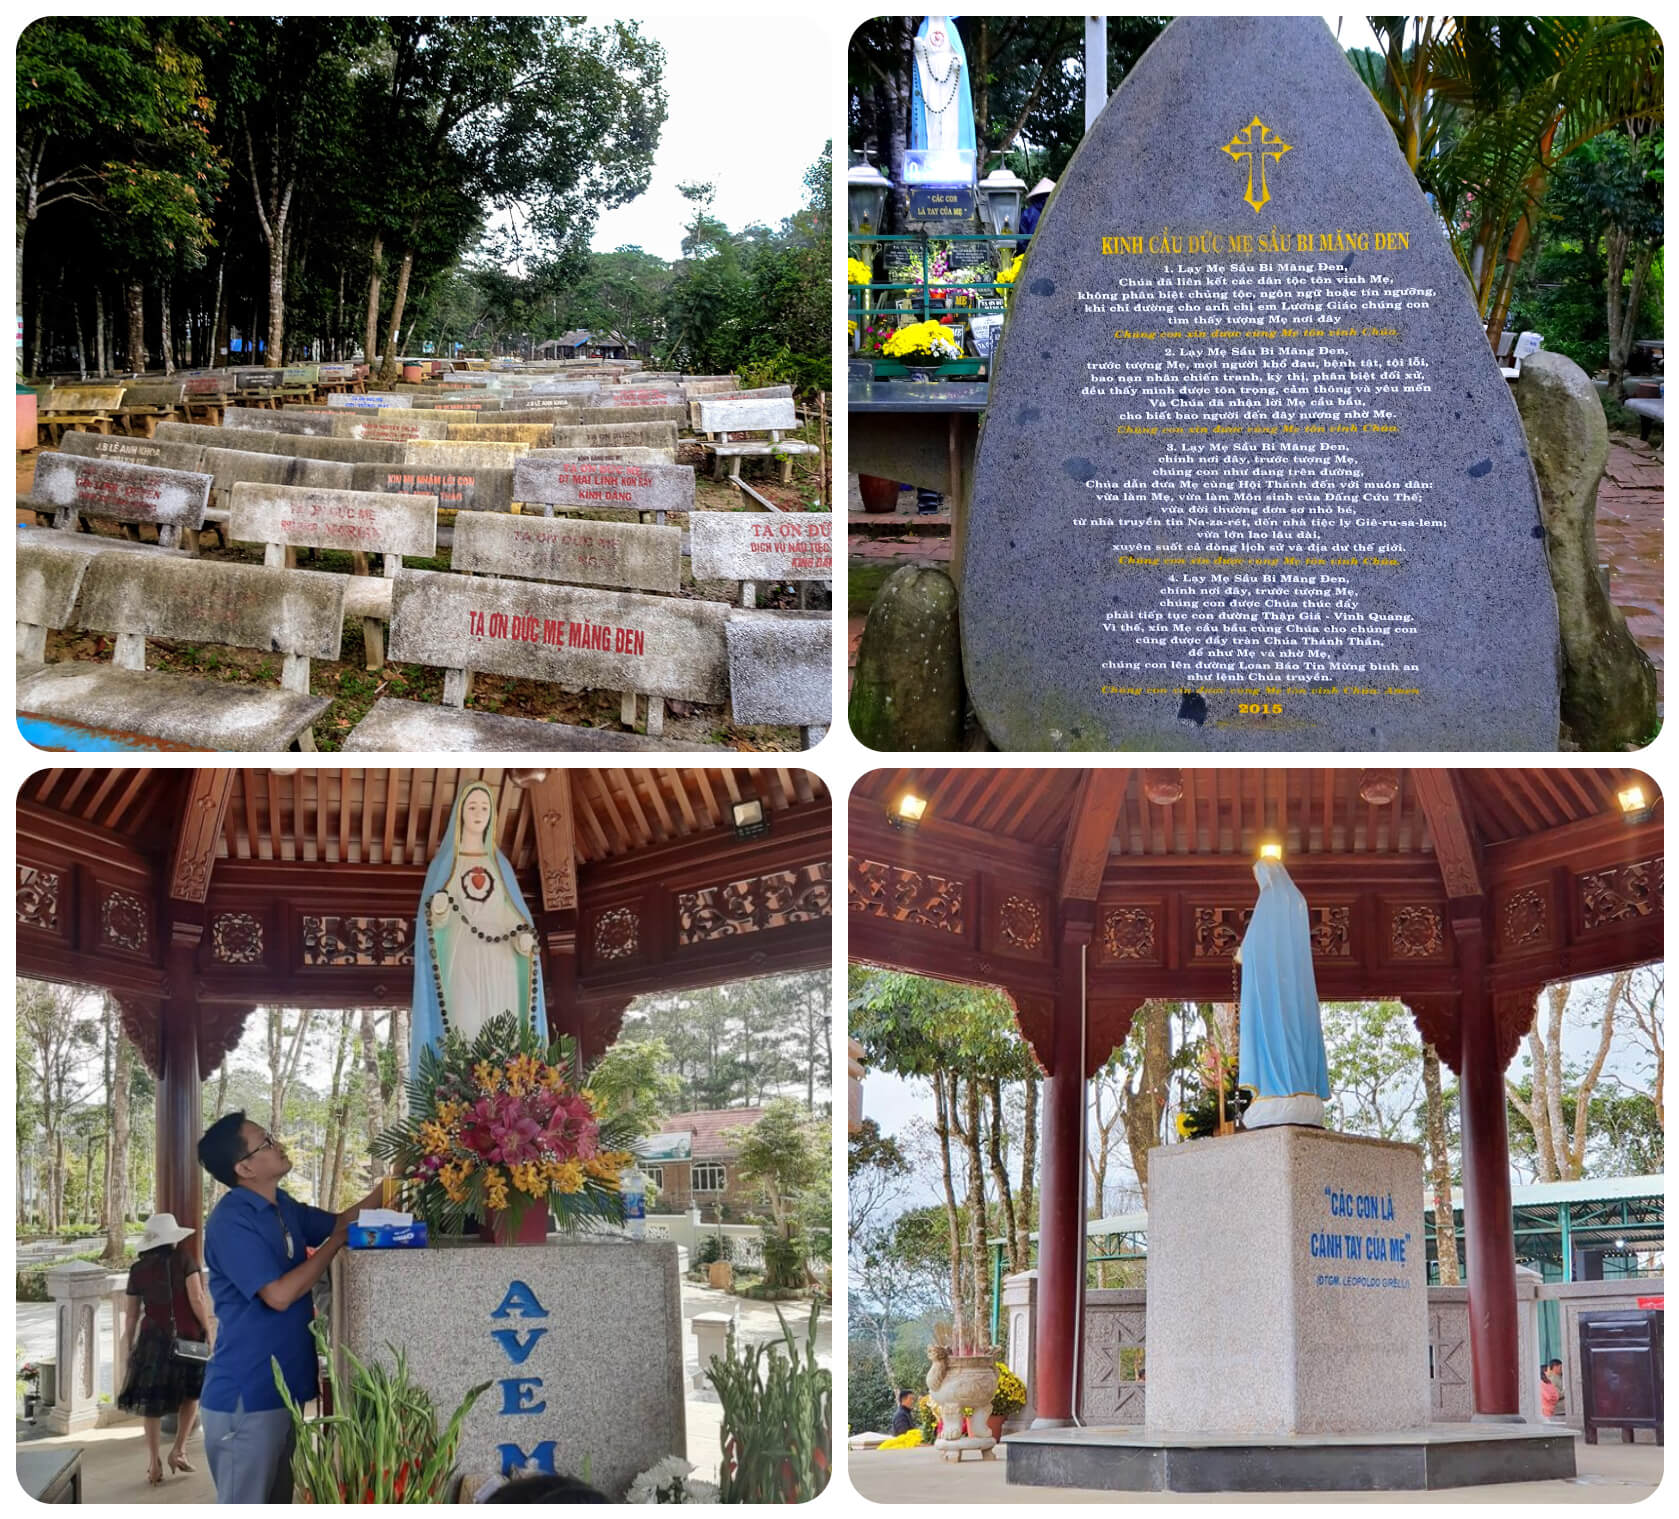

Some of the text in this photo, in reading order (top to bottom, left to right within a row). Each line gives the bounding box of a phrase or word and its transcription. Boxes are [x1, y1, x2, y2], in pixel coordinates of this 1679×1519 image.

[1102, 236, 1143, 254] KINH
[1149, 227, 1182, 254] CẦU
[1228, 234, 1252, 256] MẸ
[1258, 225, 1291, 252] SẦU
[1296, 234, 1314, 251] BI
[1320, 229, 1368, 251] MĂNG
[1374, 232, 1410, 250] ĐEN
[1164, 265, 1174, 273] 1.
[1259, 264, 1273, 272] Bi
[1336, 275, 1366, 284] vinh
[1085, 304, 1105, 312] khi
[1178, 303, 1200, 311] cho
[1205, 302, 1229, 311] anh
[1165, 348, 1175, 356] 2.
[1260, 347, 1274, 355] Bi
[1262, 443, 1276, 451] Bi
[572, 474, 591, 485] MAI
[594, 476, 618, 486] LINH
[470, 610, 645, 656] TẠ ƠN ĐỨC MẸ MĂNG ĐEN
[1324, 625, 1347, 633] cho
[1238, 704, 1283, 714] 2015
[1357, 1195, 1378, 1219] CON
[1382, 1193, 1394, 1221] LÀ
[1311, 1227, 1342, 1258] CÁNH
[1344, 1235, 1362, 1260] TAY
[1366, 1230, 1387, 1261] CỦA
[1343, 1276, 1380, 1288] LEOPOLDO
